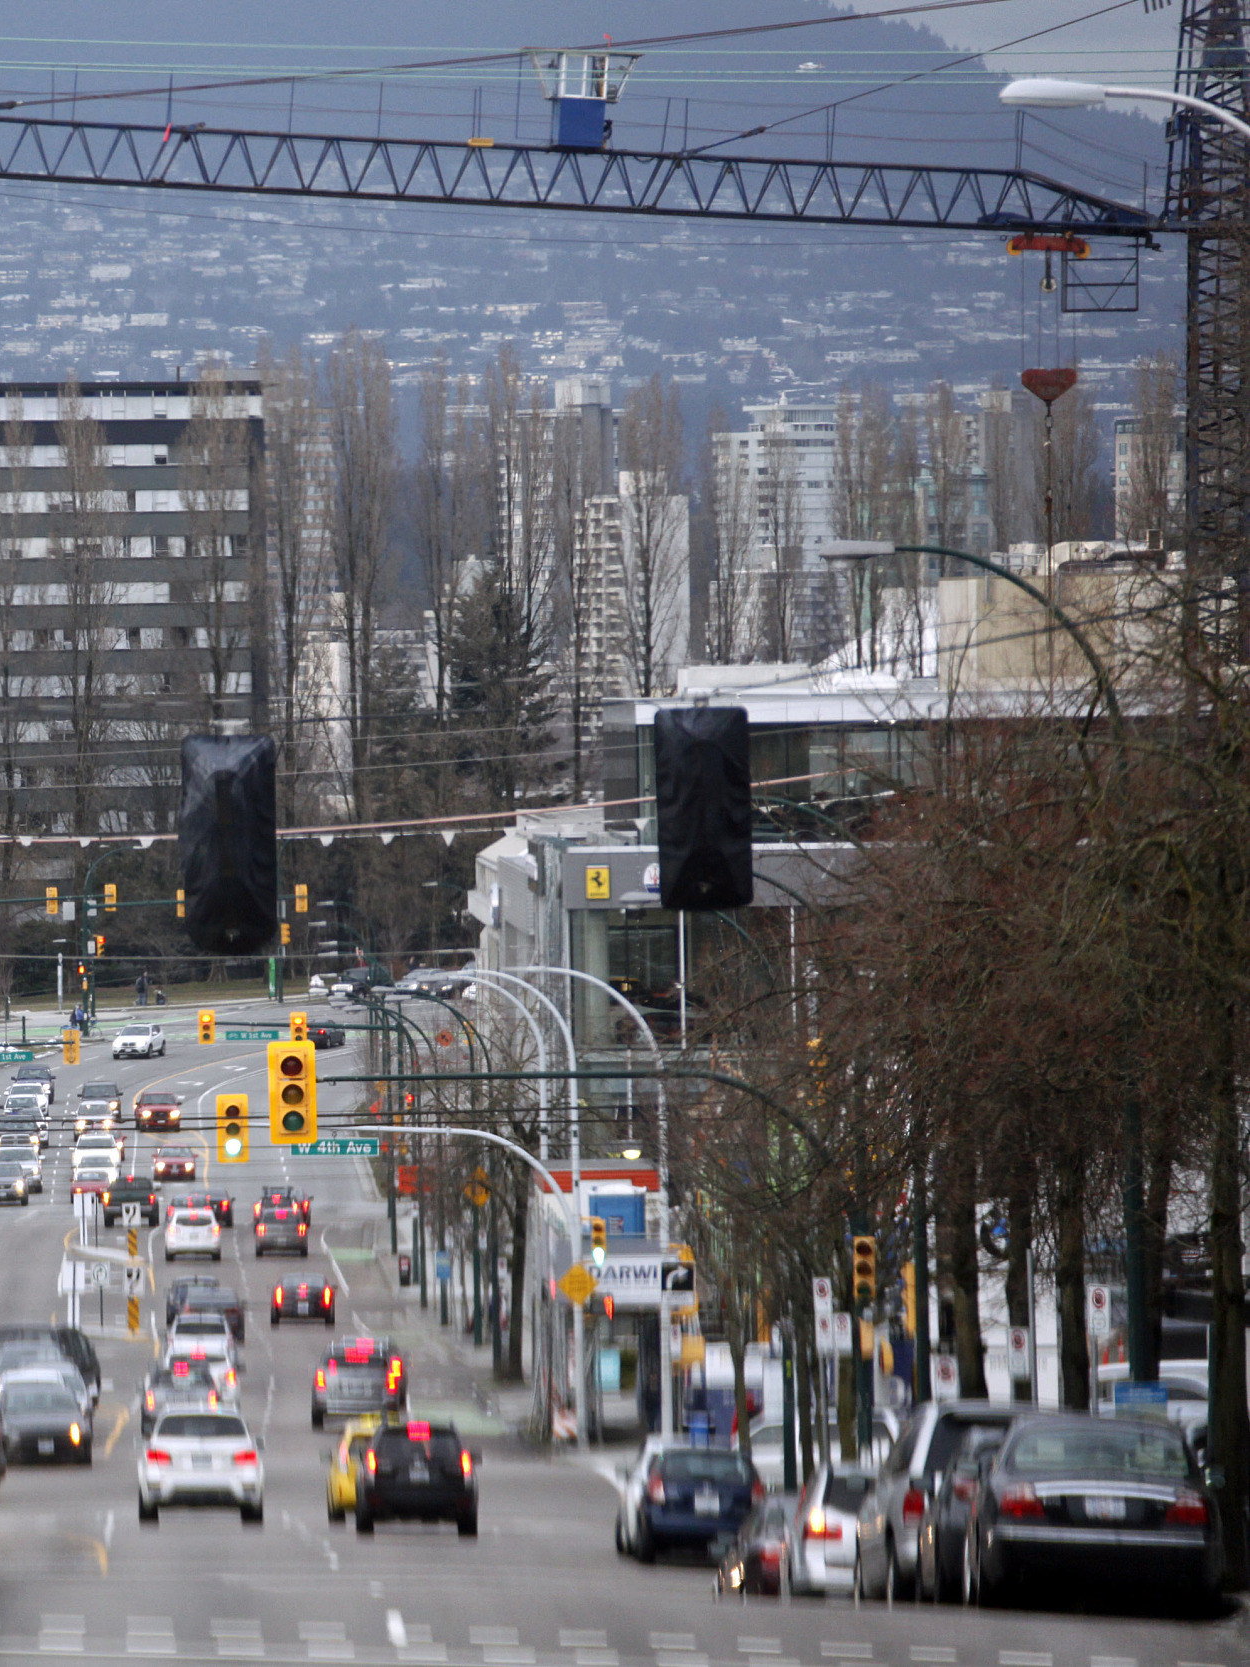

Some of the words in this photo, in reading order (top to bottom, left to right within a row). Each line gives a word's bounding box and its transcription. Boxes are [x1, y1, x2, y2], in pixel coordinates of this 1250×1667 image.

[298, 1142, 312, 1154] W
[317, 1140, 341, 1154] 4th
[346, 1140, 372, 1154] Ave
